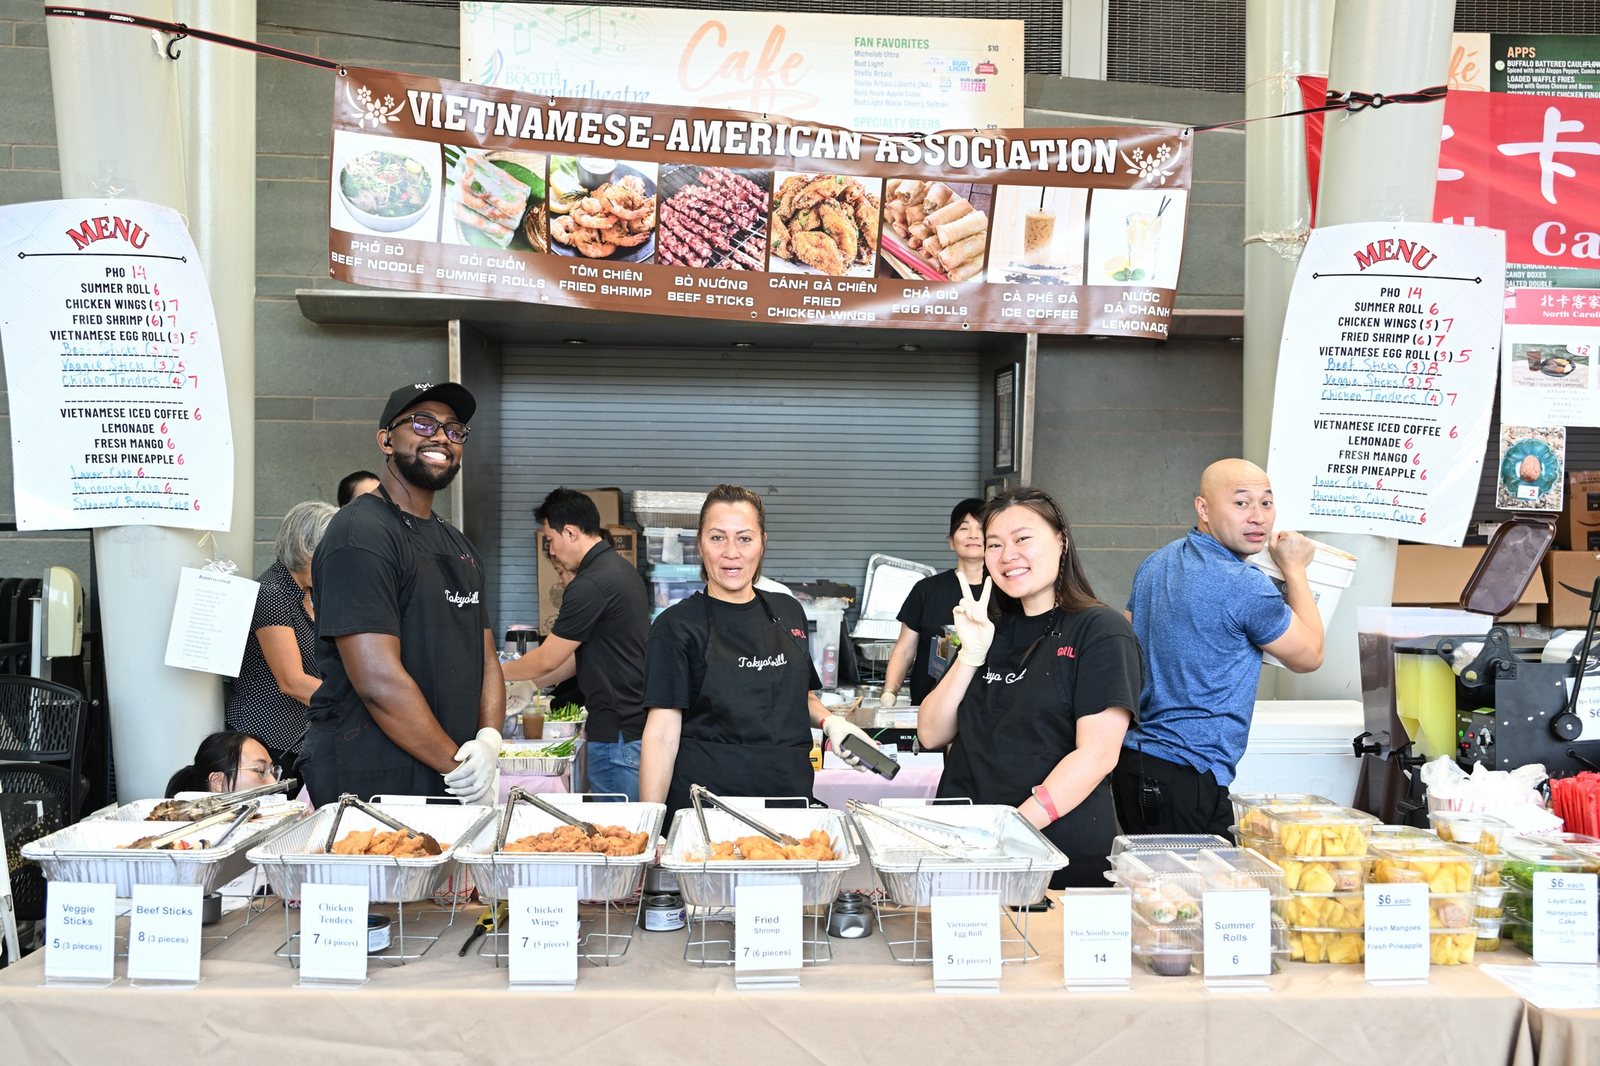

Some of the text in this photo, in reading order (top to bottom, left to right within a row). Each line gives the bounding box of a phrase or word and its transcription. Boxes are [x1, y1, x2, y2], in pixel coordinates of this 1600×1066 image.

[854, 37, 874, 48] FAN
[876, 38, 930, 50] FAVORITES
[1507, 47, 1536, 58] APPS
[868, 61, 884, 69] Light
[1535, 60, 1566, 68] BATTERED
[960, 83, 987, 92] SELTZER
[854, 117, 941, 129] SPECIALTY BEERS
[406, 90, 1119, 175] VIETNAMESE-AMERICAN ASSOCIATION
[66, 216, 150, 251] MENU
[351, 240, 404, 256] PHỞ BÒ
[1354, 238, 1438, 271] MENU
[332, 251, 425, 274] BEEF NOODLE
[106, 265, 146, 280] PHO 14
[570, 264, 643, 282] TÔM CHIÊN
[436, 269, 546, 289] SUMMER ROLLS
[675, 274, 748, 290] BÒ NƯỚNG
[769, 276, 878, 294] CÁNH GÀ CHIÊN
[81, 283, 160, 296] SUMMER ROLL 6
[560, 280, 653, 298] FRIED SHRIMP
[1380, 286, 1422, 299] PHO 14
[668, 292, 754, 307] BEEF STICKS
[804, 296, 841, 307] FRIED
[1003, 290, 1078, 304] CÀ PHÊ ĐÁ
[1122, 288, 1160, 303] NƯỚC
[66, 299, 146, 310] CHICKEN WINGS
[892, 304, 968, 316] EGG ROLLS
[1104, 302, 1171, 318] ĐÁ CHANH
[1354, 302, 1439, 315] SUMMER ROLL 6
[73, 315, 142, 325] FRIED SHRIMP
[768, 307, 876, 322] CHICKEN WINGS
[1002, 308, 1078, 320] ICE COFFEE
[1543, 310, 1570, 318] North
[1102, 320, 1169, 336] LEMONADE
[1338, 316, 1454, 332] CHICKEN WINGS 7
[50, 330, 166, 342] VIETNAMESE EGG ROLL
[1342, 332, 1446, 348] FRIED SHRIMP 7
[1320, 346, 1472, 363] VIETNAMESE EGG ROLL 5
[1576, 346, 1588, 356] 12
[1328, 358, 1438, 374] Beef Sticks 8
[1324, 372, 1434, 390] Veggie Sticks 5
[1321, 389, 1458, 406] Chicken Tenders 7
[60, 408, 202, 420] VIETNAMESE ICED COFFEE 6
[102, 422, 168, 434] LEMONADE 6
[1314, 420, 1458, 438] VIETNAMESE ICED COFFEE 6
[94, 438, 176, 450] FRESH MANGO 6
[1348, 436, 1414, 450] LEMONADE 6
[85, 454, 184, 465] FRESH PINEAPPLE 6
[1339, 450, 1420, 466] FRESH MANGO 6
[1328, 464, 1427, 481] FRESH PINEAPPLE 6
[1529, 489, 1536, 497] 2
[1551, 878, 1564, 888] $6
[1378, 894, 1392, 905] $6
[62, 904, 95, 914] Veggie
[136, 906, 193, 916] Beef Sticks
[318, 903, 354, 912] Chicken
[526, 906, 563, 914] Chicken
[64, 916, 93, 926] Sticks
[320, 915, 352, 924] Tenders
[532, 918, 559, 927] Wings
[754, 916, 780, 924] Fried
[1214, 922, 1255, 930] Summer
[138, 932, 146, 942] 8
[314, 933, 320, 944] 7
[522, 936, 529, 948] 7
[1223, 934, 1248, 942] Rolls
[53, 938, 60, 949] 5
[744, 947, 750, 957] 7
[947, 955, 954, 965] 5
[1094, 954, 1106, 963] 14
[1232, 954, 1239, 965] 6
